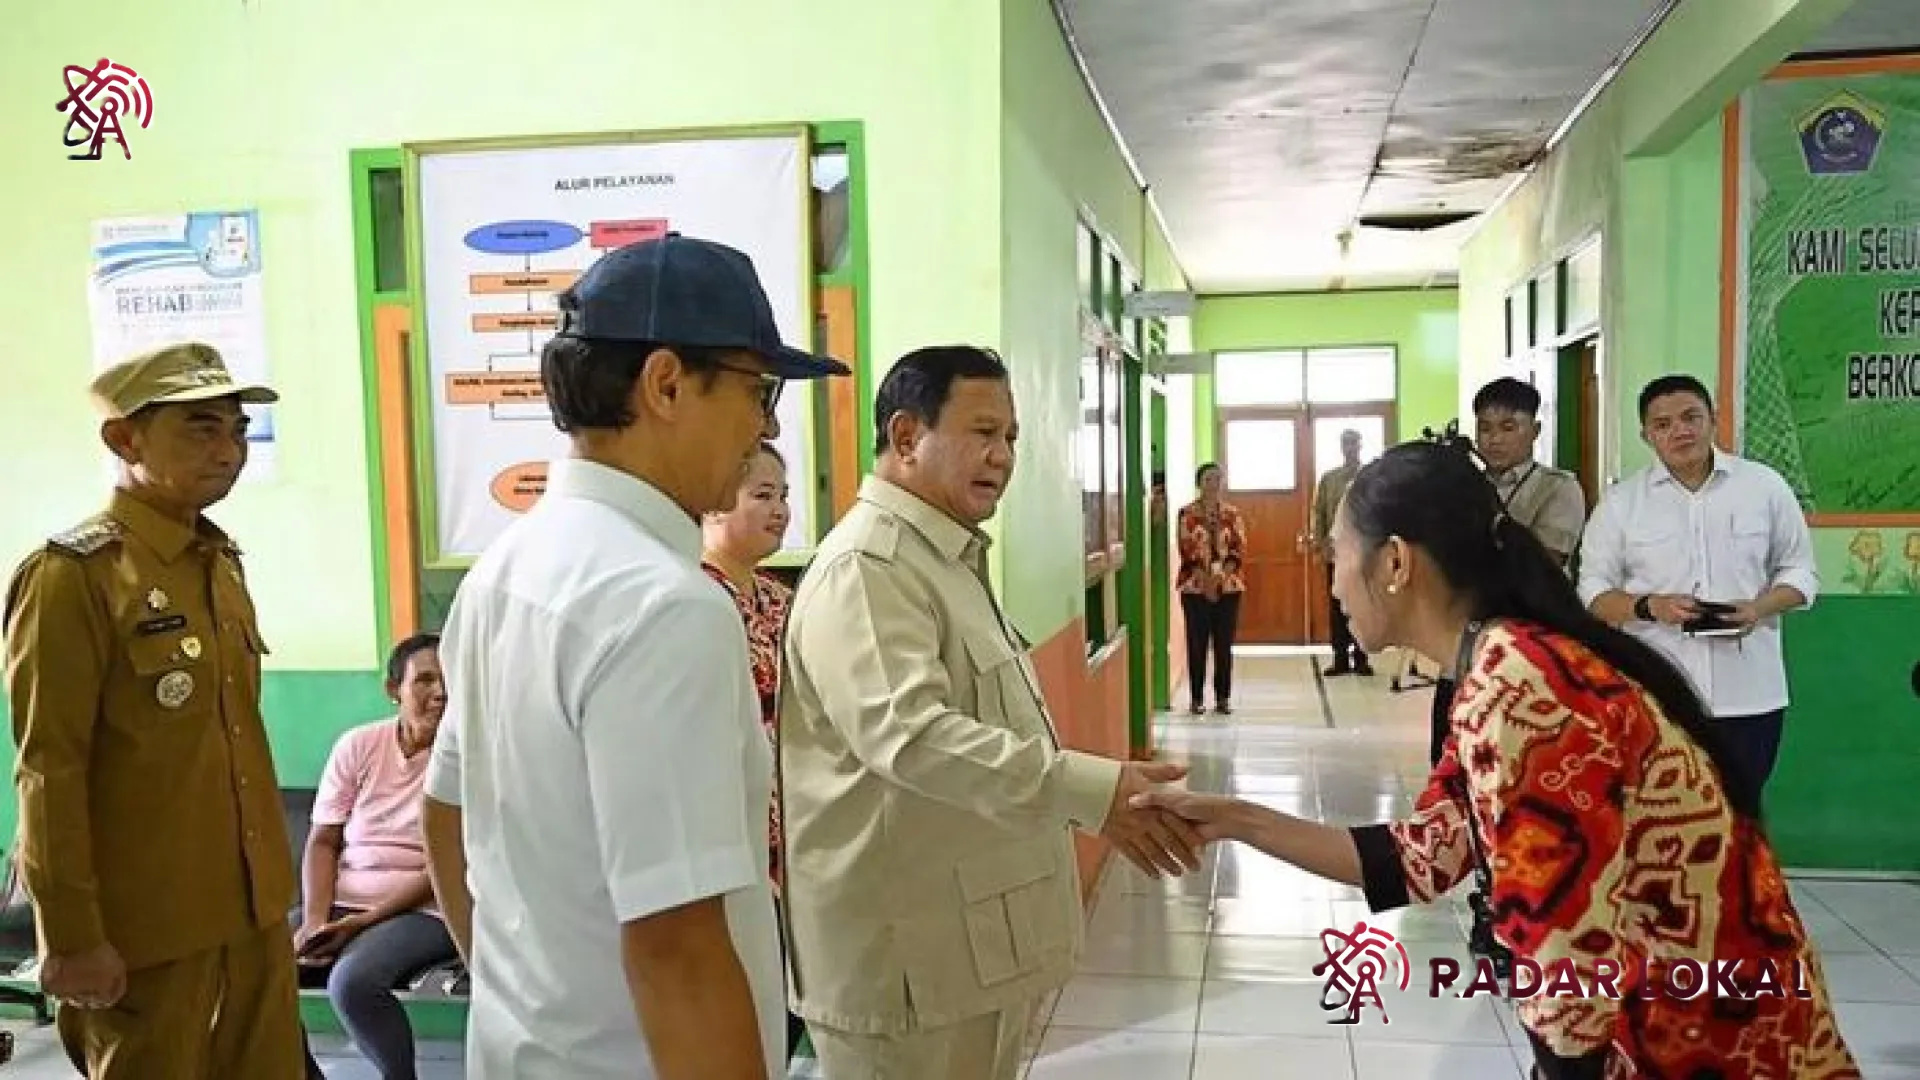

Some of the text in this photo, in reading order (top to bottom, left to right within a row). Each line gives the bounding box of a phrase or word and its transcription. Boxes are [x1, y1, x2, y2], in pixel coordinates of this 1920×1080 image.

[554, 173, 675, 191] ALUR PELAYANAN
[1787, 229, 1847, 274] KAMI
[115, 292, 193, 314] REHAB
